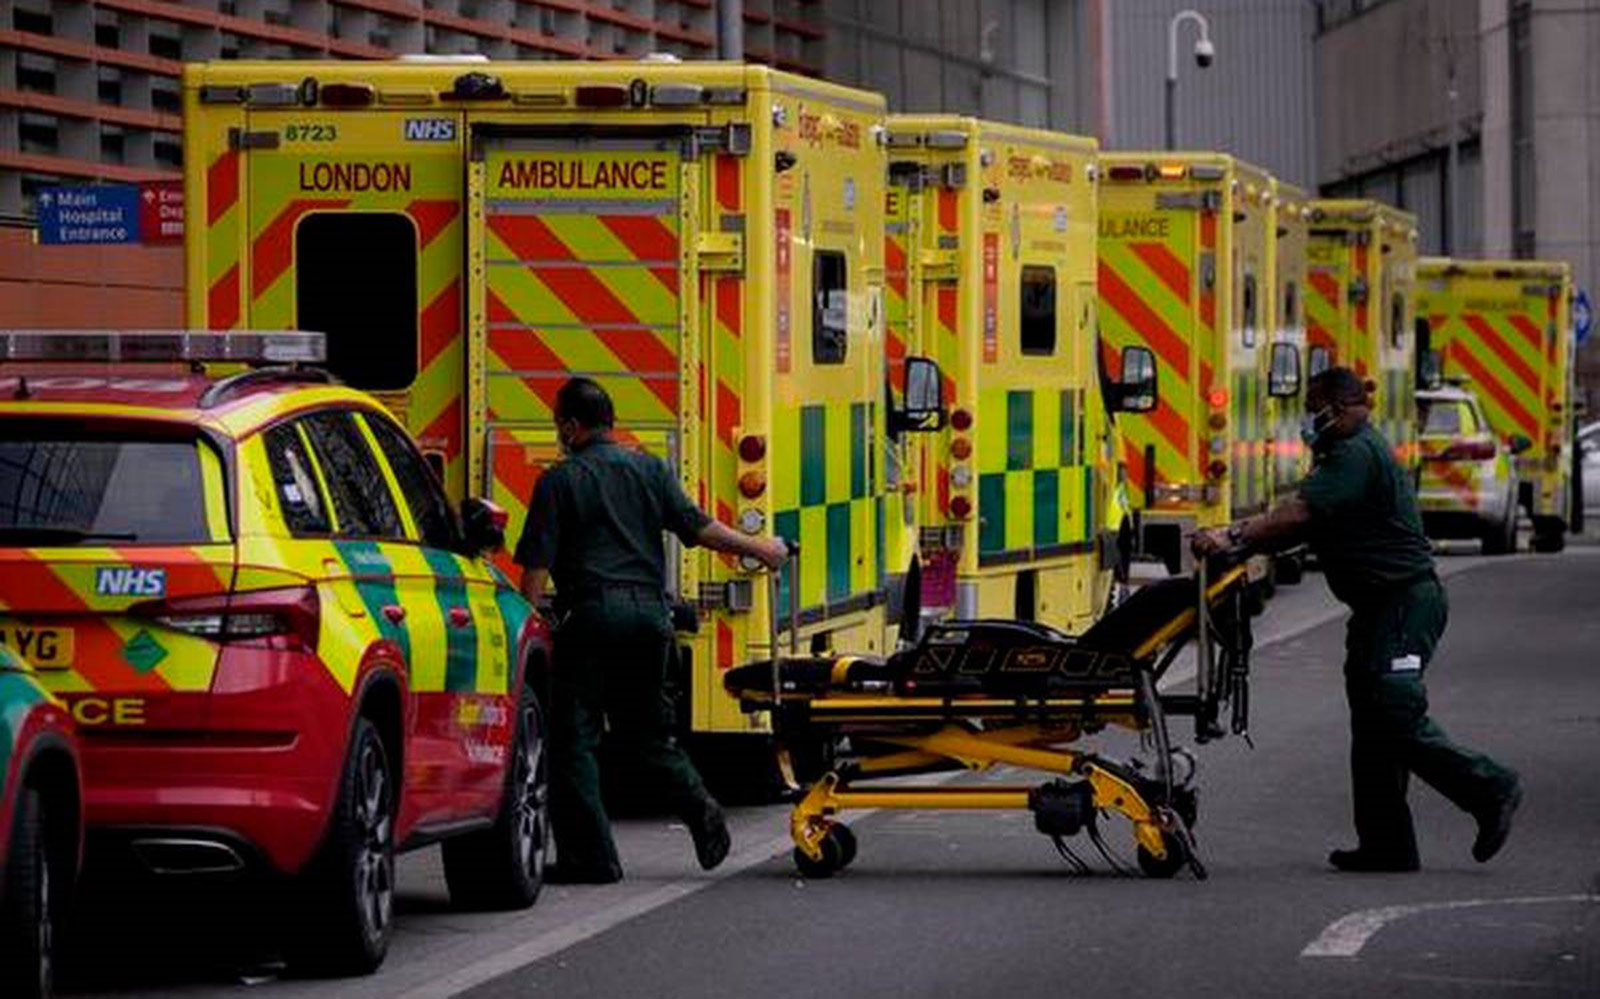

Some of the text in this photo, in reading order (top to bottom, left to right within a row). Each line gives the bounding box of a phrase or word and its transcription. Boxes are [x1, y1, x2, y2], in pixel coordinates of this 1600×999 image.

[285, 125, 337, 142] 8723
[407, 119, 455, 139] NHS
[299, 163, 411, 192] LONDON
[499, 160, 668, 190] AMBULANCE
[58, 191, 98, 207] Main
[59, 208, 123, 226] Hospital
[60, 226, 127, 242] Entrance
[98, 569, 164, 594] NHS
